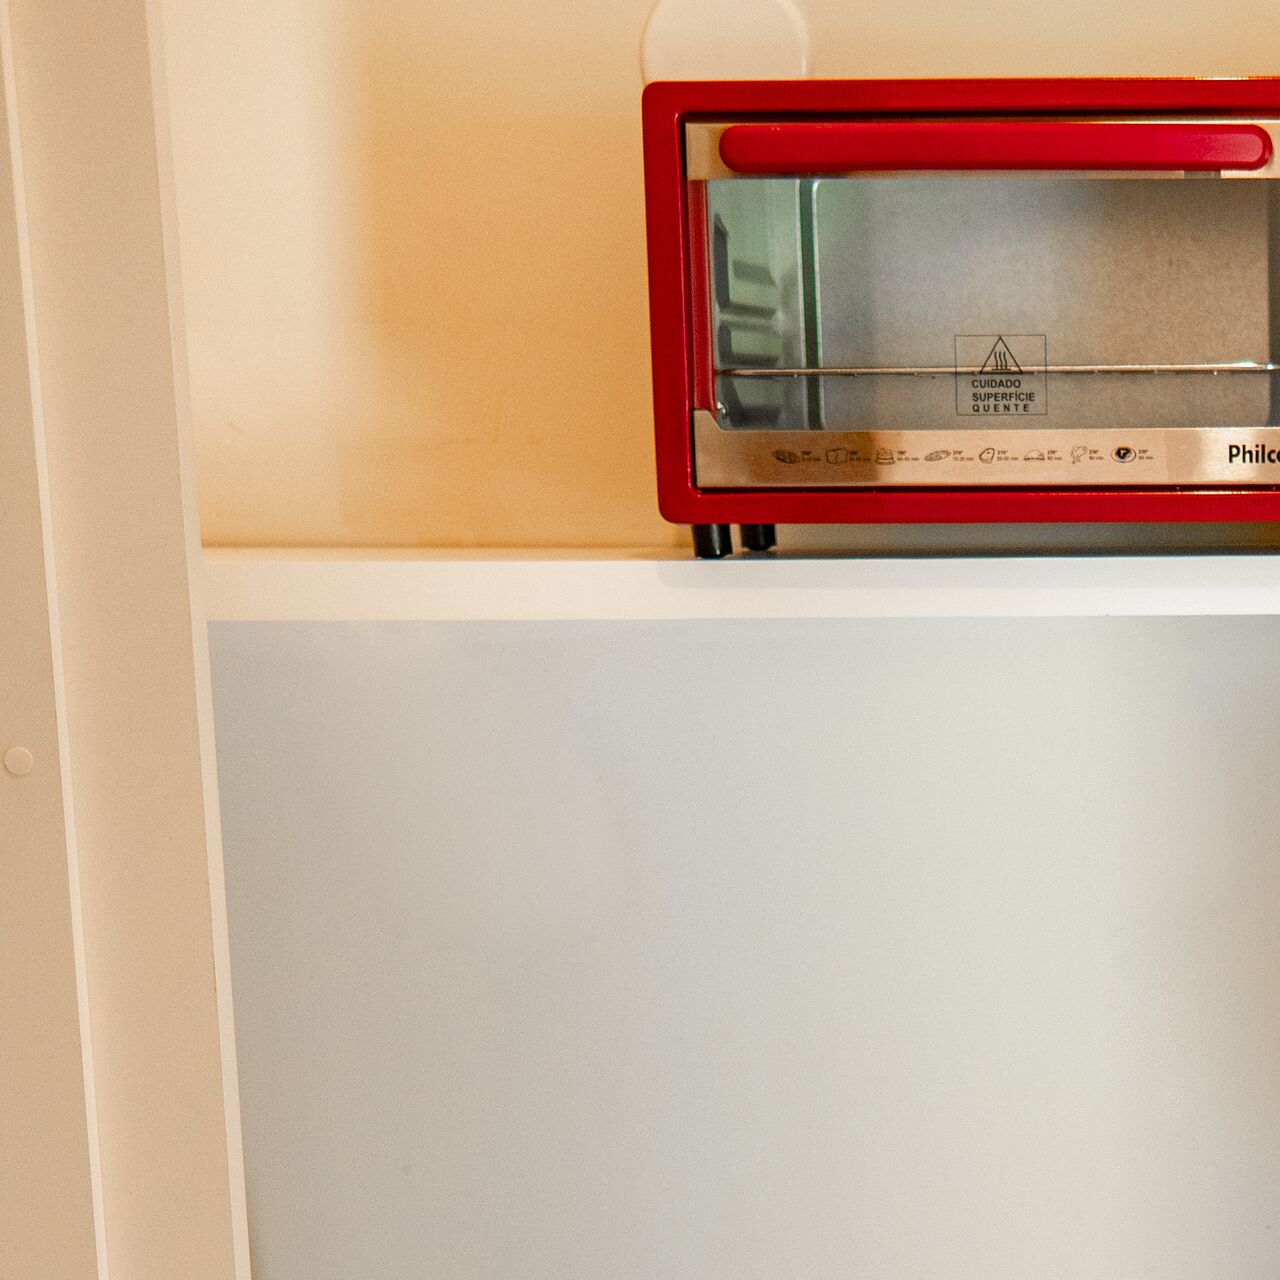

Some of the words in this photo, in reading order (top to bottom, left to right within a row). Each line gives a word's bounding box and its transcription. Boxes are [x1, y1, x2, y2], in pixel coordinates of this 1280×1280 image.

[971, 380, 1021, 388] CUIDADO
[972, 390, 1036, 402] SUPERFÍCIE
[972, 404, 1030, 413] QUENTE
